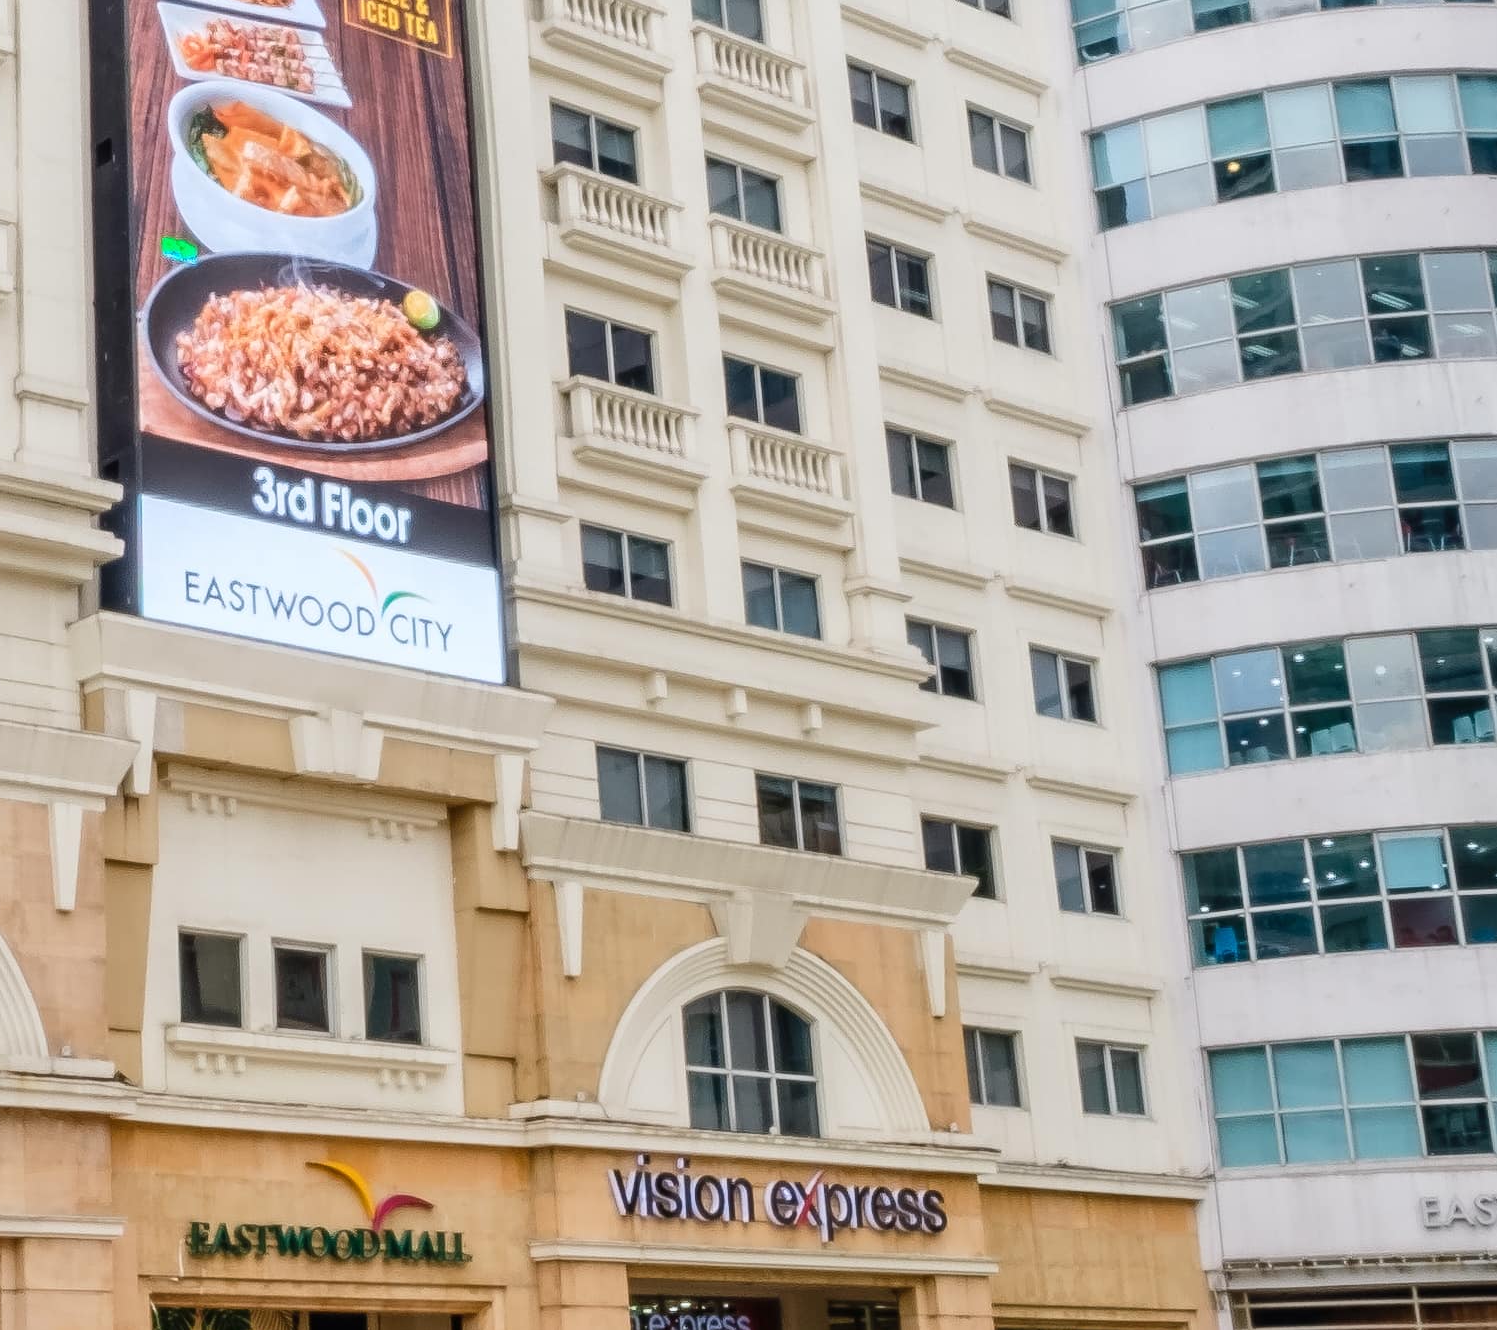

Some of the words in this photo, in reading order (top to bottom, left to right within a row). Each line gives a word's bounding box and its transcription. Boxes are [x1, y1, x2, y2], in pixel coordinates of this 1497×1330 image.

[405, 13, 439, 45] TEA
[252, 466, 316, 523] 3rd
[321, 481, 412, 543] Floor
[184, 570, 376, 636] EASTWOOD
[389, 613, 453, 652] CITY
[609, 1153, 756, 1224] vision
[763, 1170, 949, 1244] express
[185, 1221, 381, 1262] EASTWOOD
[382, 1228, 466, 1263] MALL
